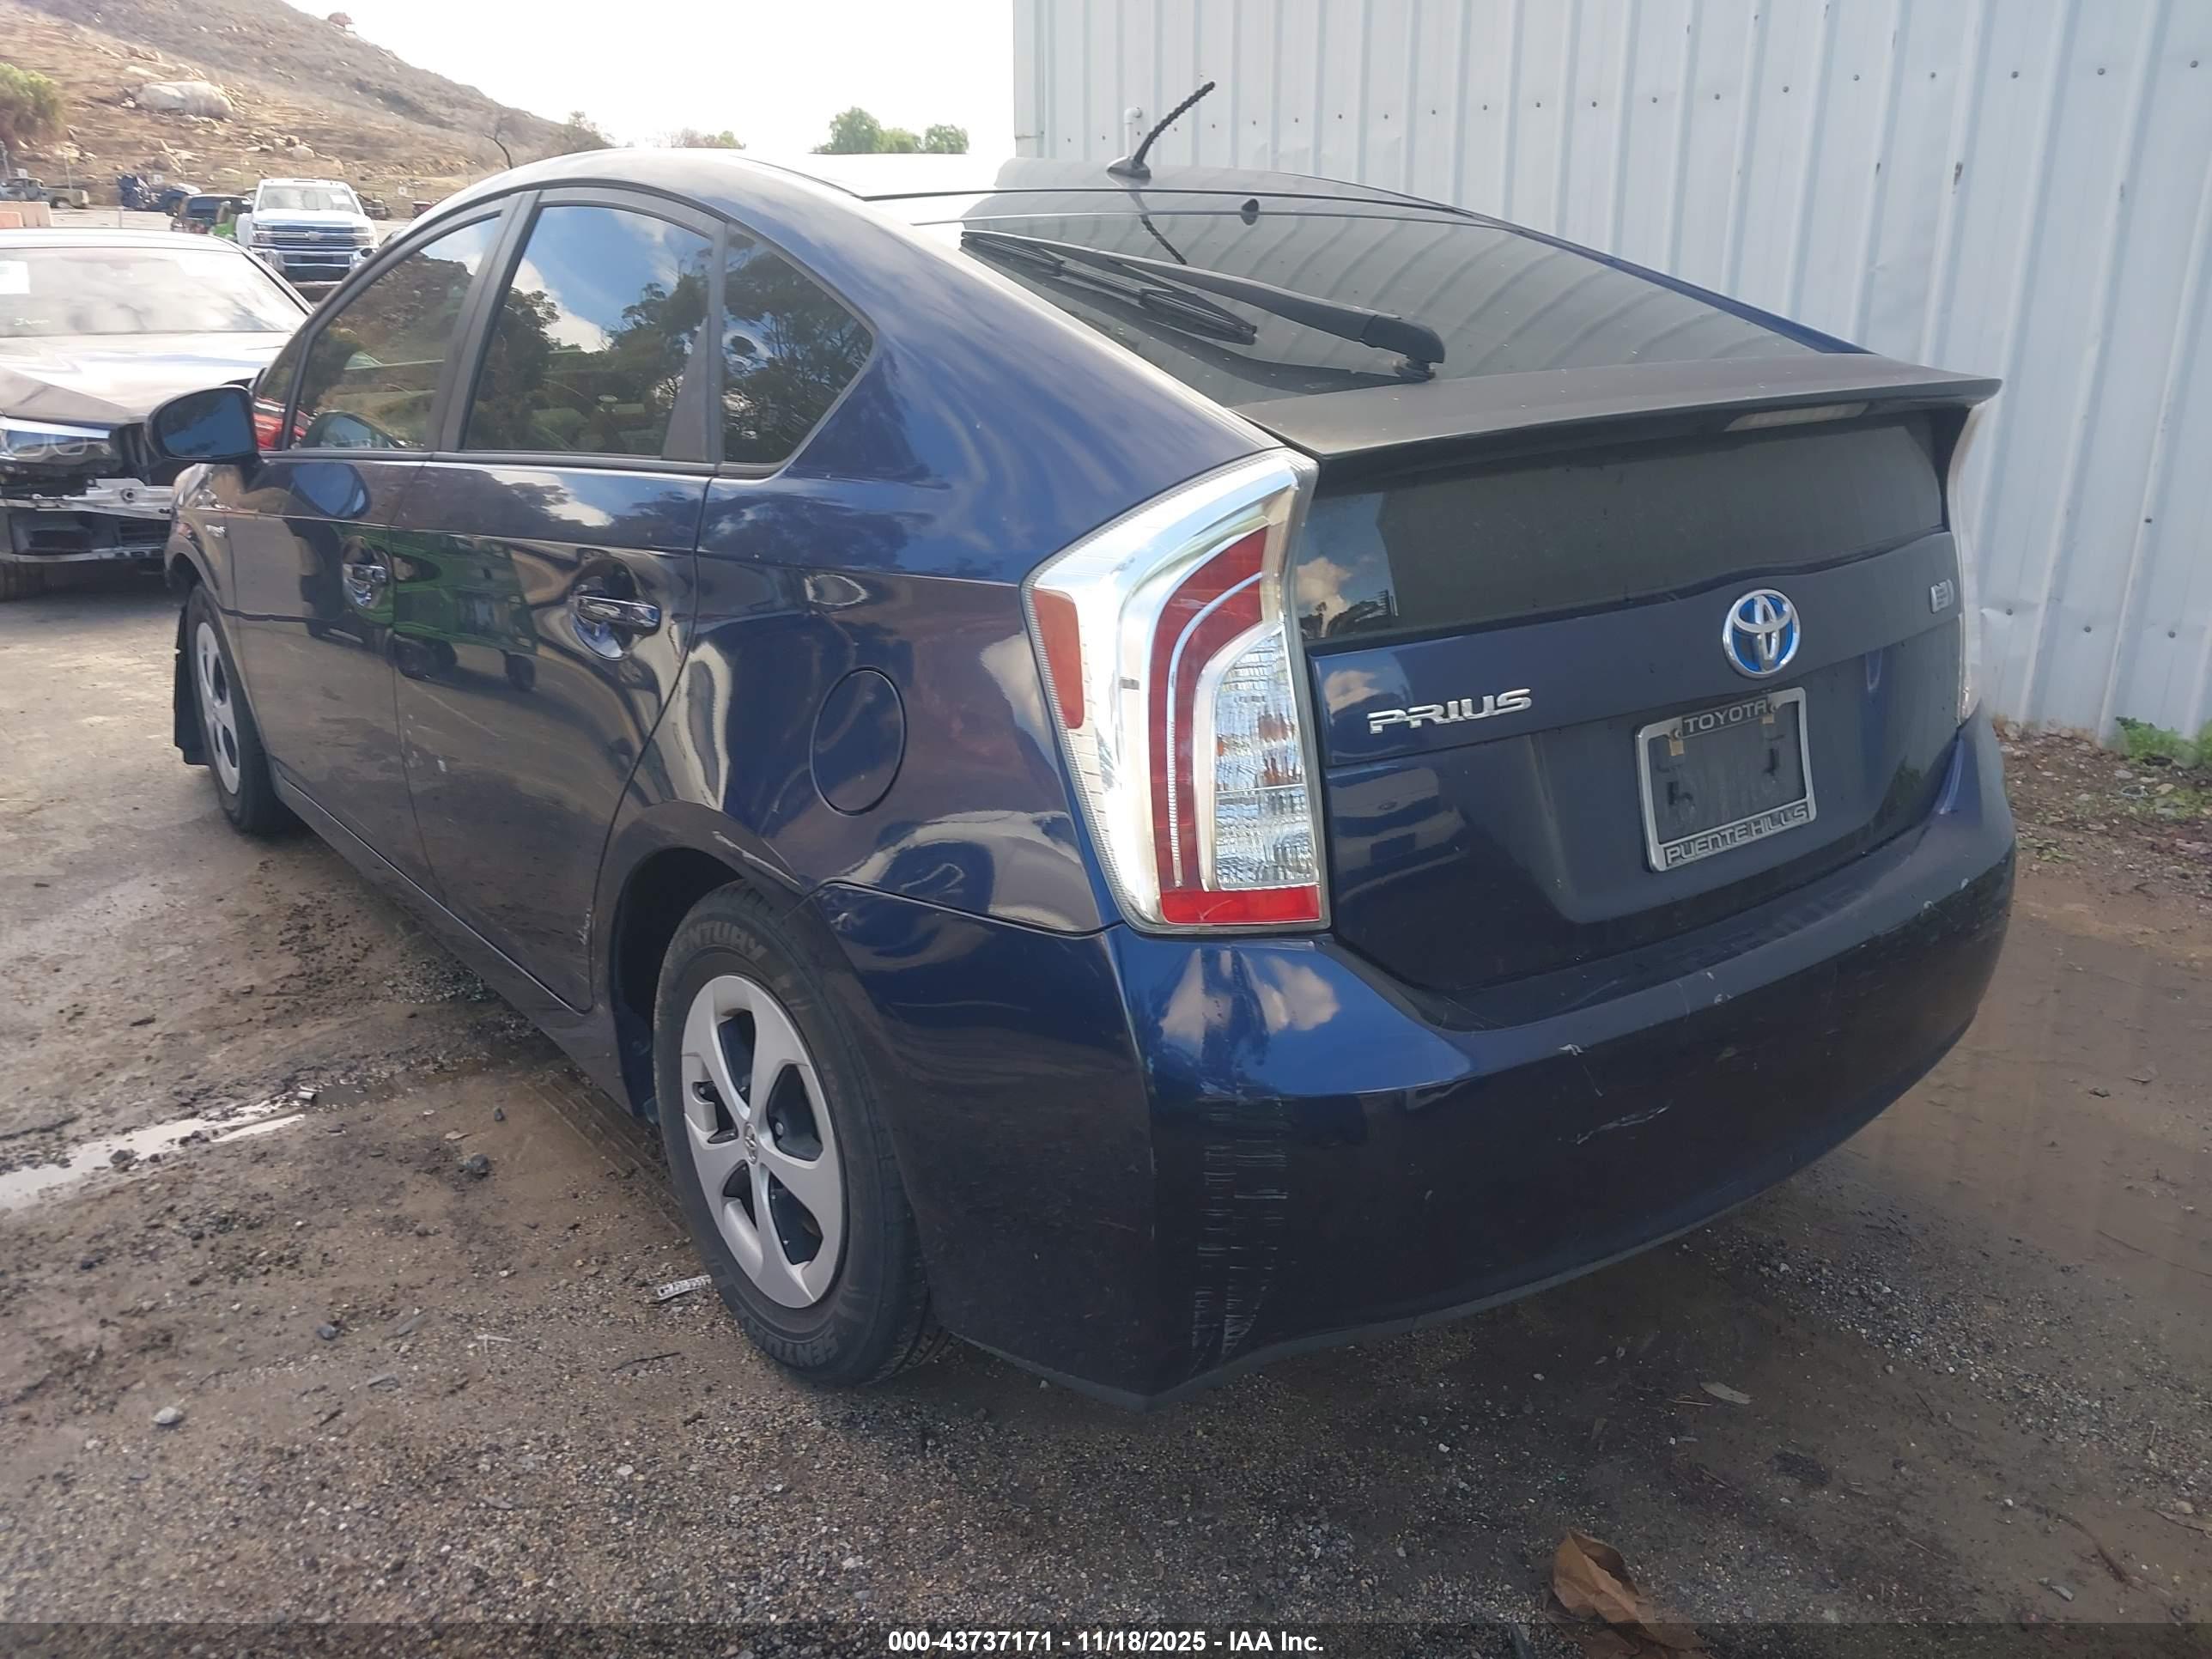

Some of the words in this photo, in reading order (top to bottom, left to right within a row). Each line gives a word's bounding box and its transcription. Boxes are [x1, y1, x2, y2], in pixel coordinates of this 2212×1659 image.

[1367, 688, 1533, 734] PRIUS
[1684, 700, 1768, 733] TOYOTA
[1665, 823, 1749, 865] PUENTE
[1750, 805, 1808, 836] HILLS
[668, 921, 768, 961] ENTURY
